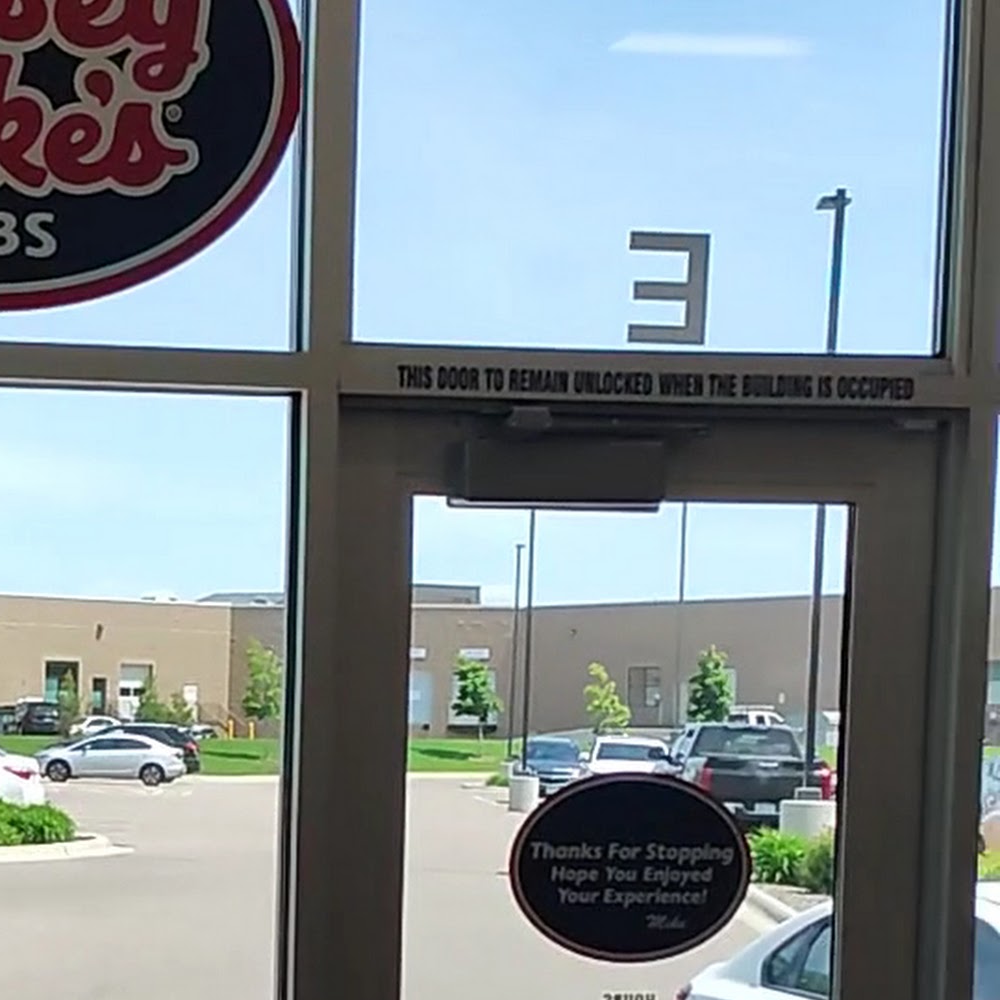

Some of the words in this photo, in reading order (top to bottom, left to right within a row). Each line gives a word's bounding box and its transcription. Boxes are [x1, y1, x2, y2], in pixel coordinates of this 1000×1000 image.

[397, 364, 432, 390] THIS
[436, 366, 480, 391] DOOR
[484, 367, 505, 391] TO
[508, 368, 569, 394] REMAIN
[573, 370, 653, 395] UNLOCKED
[658, 372, 703, 397] WHEN
[708, 373, 738, 398] THE
[741, 374, 813, 399] BUILDING
[817, 375, 833, 398] IS
[836, 376, 914, 400] OCCUPIED
[531, 841, 602, 860] Thanks
[607, 842, 641, 860] For
[645, 843, 735, 866] Stopping
[550, 865, 600, 887] Hope
[605, 866, 637, 883] You
[642, 866, 714, 888] Enjoyed
[557, 887, 600, 904] Your
[602, 887, 708, 909] Experience!
